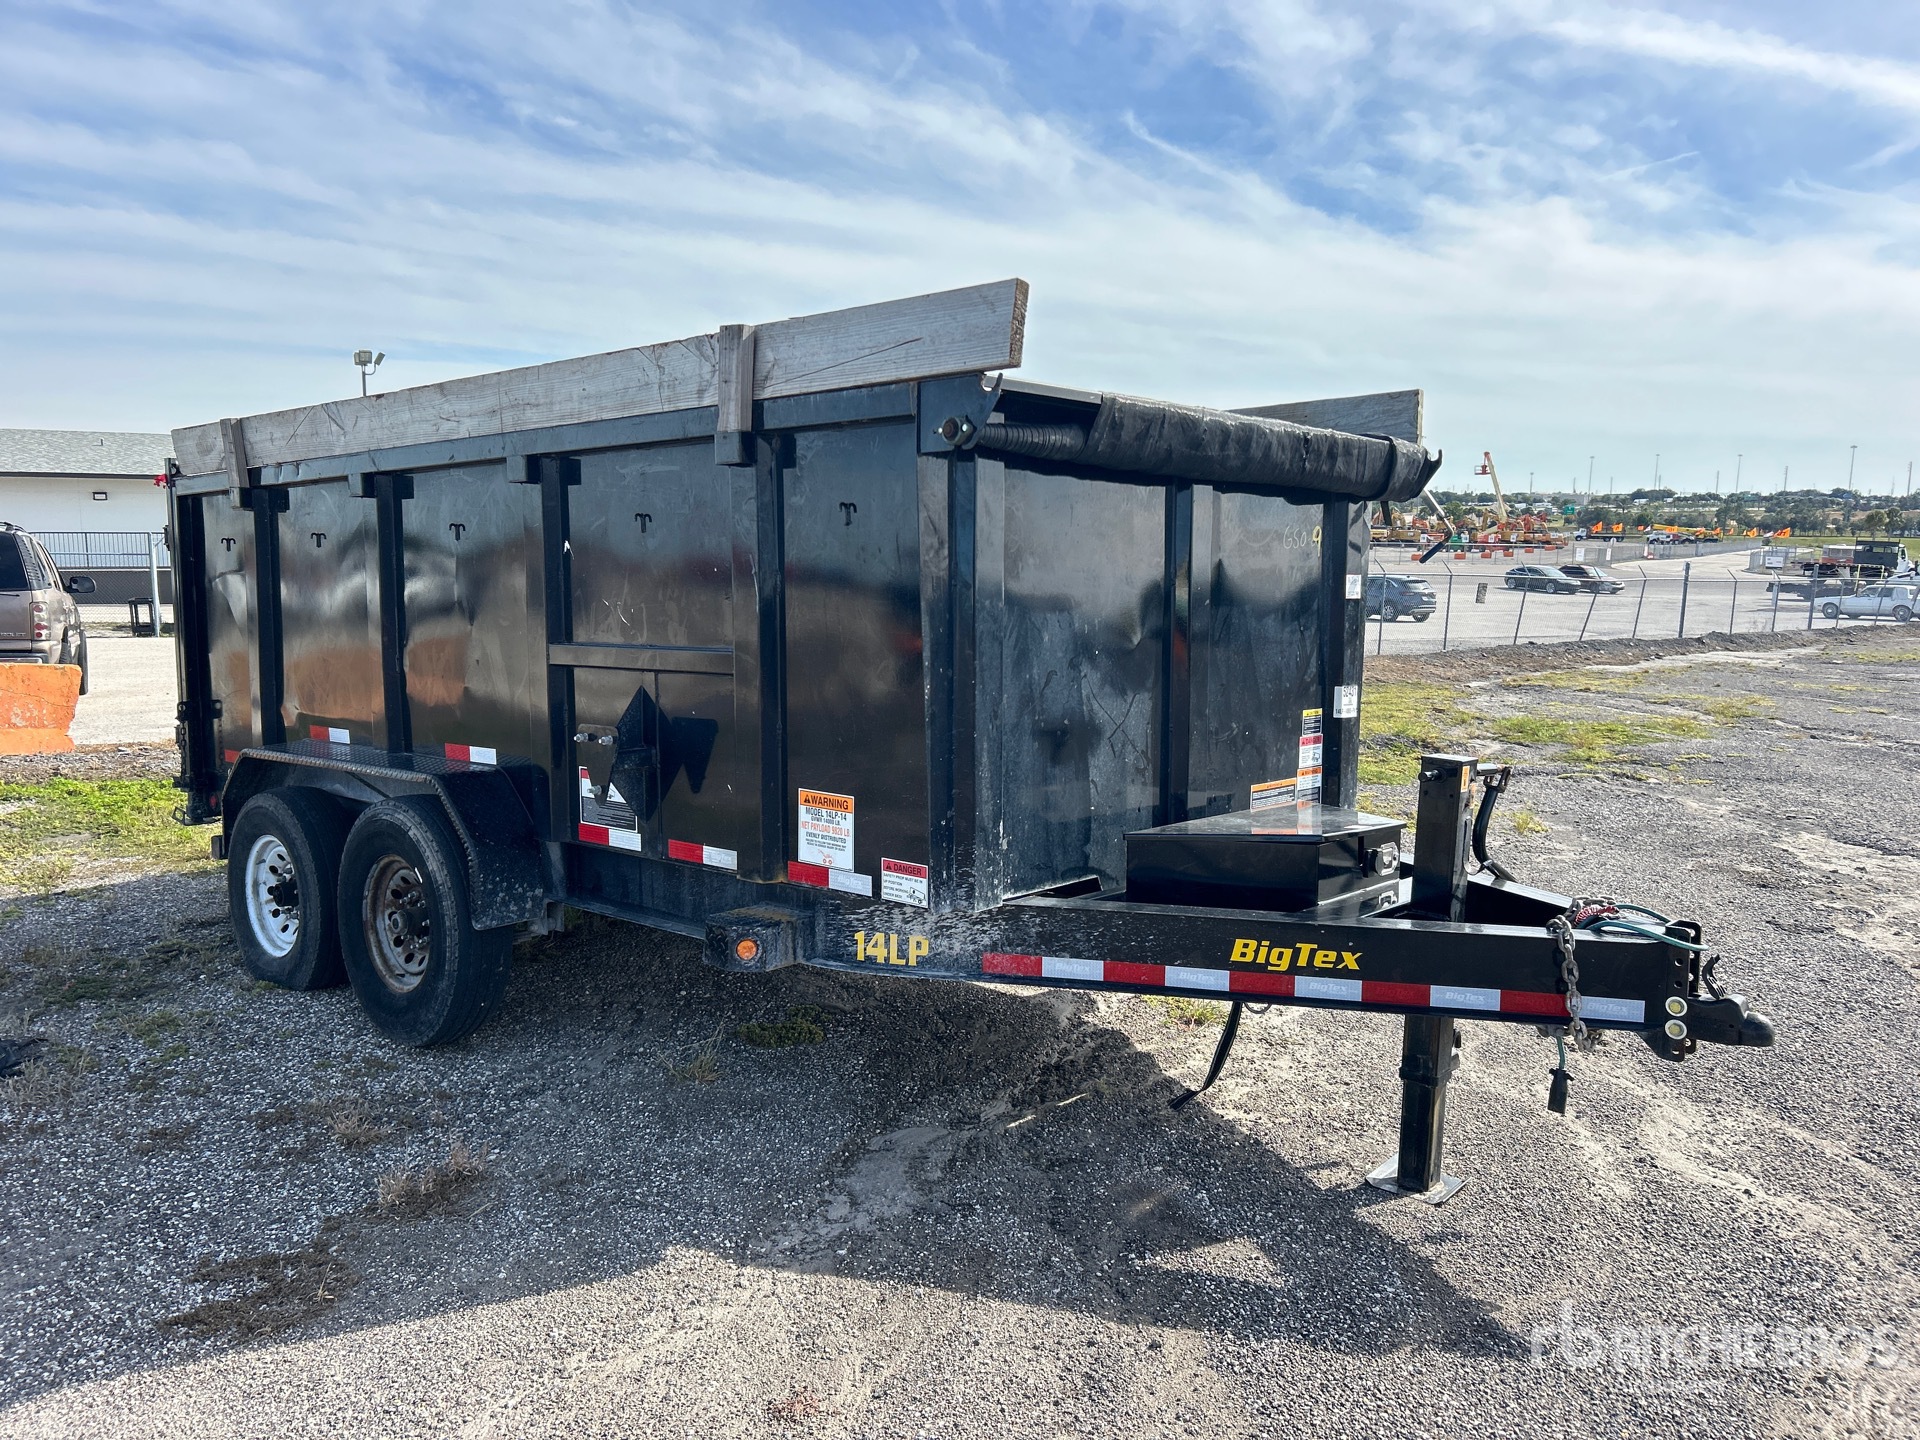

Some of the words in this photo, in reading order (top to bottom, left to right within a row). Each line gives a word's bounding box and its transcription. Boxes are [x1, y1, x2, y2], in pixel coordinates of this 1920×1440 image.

[810, 795, 849, 810] WARNING
[805, 806, 824, 817] MODEL
[825, 810, 847, 821] 14LP-14
[801, 821, 810, 829] NET
[811, 822, 831, 833] PAYLOAD
[820, 834, 847, 844] DISTRIBUTED
[893, 863, 922, 876] DANGER
[853, 930, 930, 967] 14LP
[1229, 938, 1364, 972] BigTex
[1308, 981, 1348, 994] BigTex
[1444, 990, 1486, 1003] BigTex
[1587, 1002, 1628, 1014] BigTex
